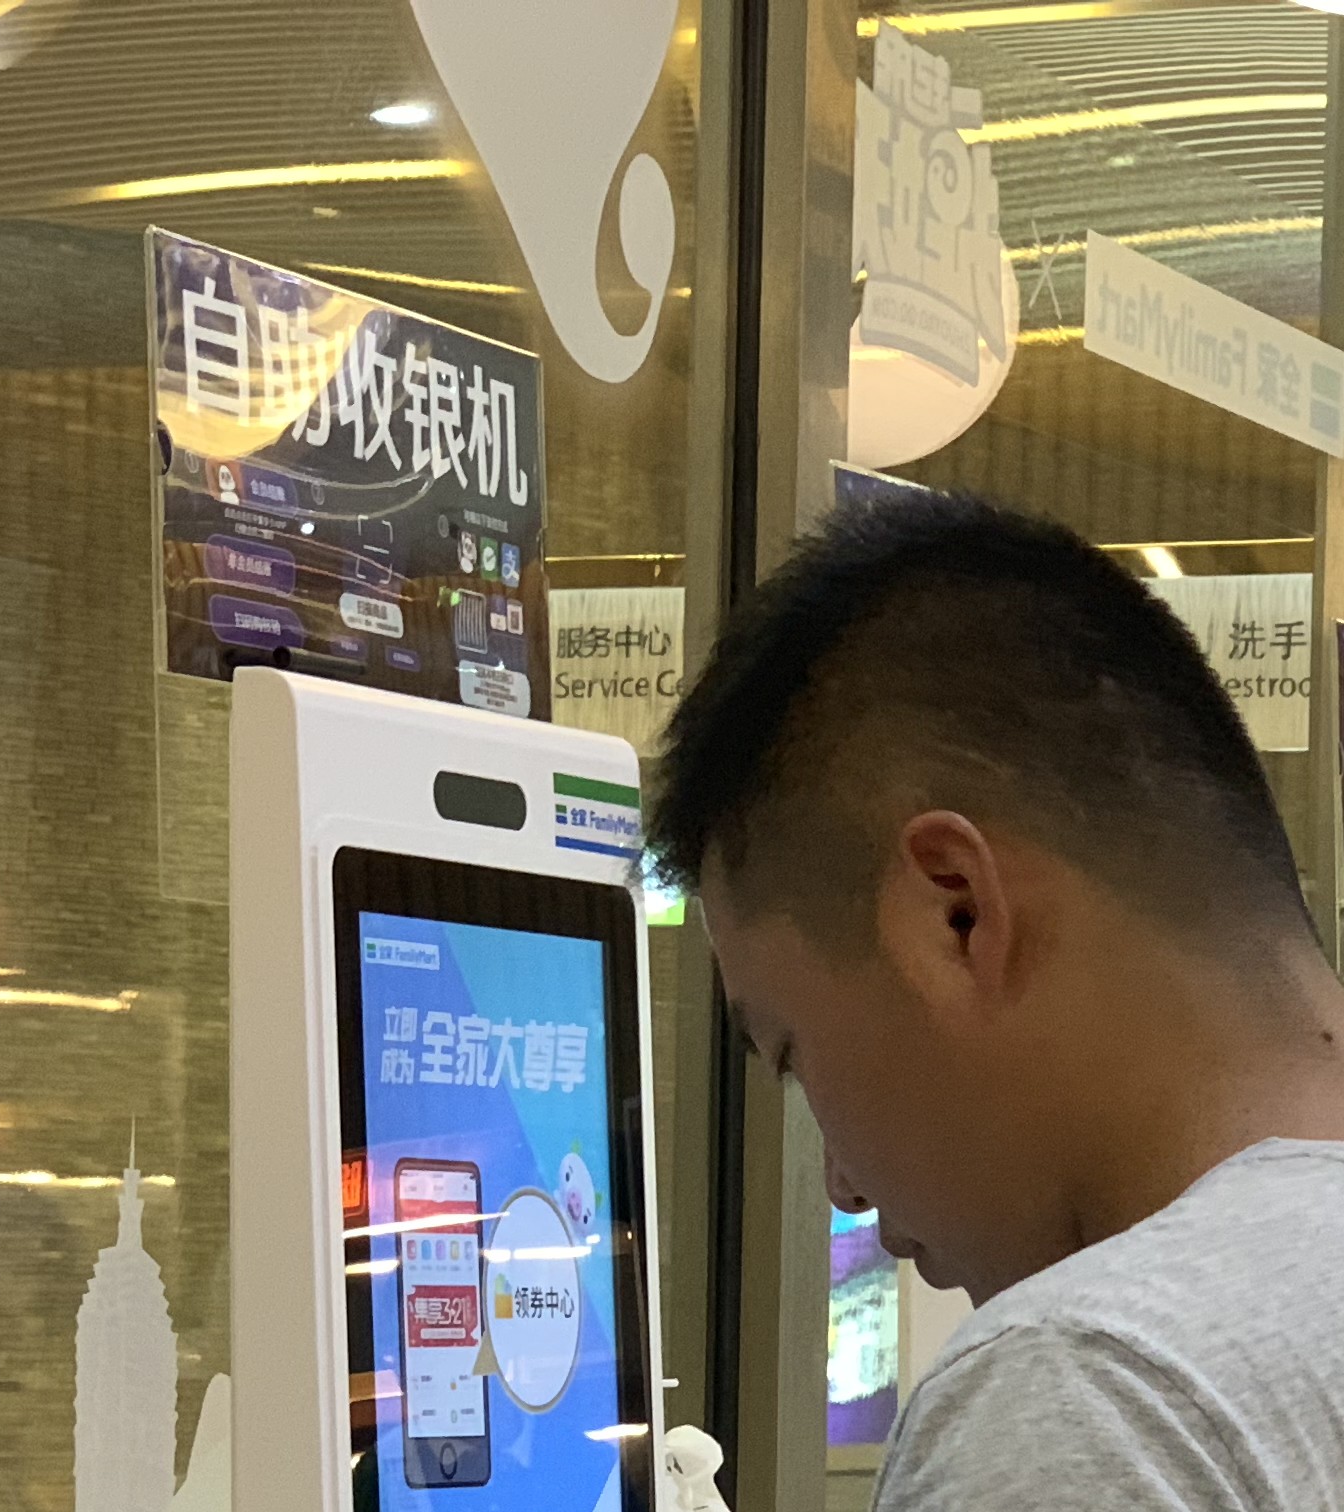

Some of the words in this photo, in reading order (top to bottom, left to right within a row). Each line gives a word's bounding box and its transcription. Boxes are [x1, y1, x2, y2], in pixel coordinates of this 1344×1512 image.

[182, 278, 527, 506] 自助收银机
[556, 624, 672, 659] 服务中心
[1228, 620, 1307, 661] 洗手
[554, 671, 650, 699] Service
[419, 1011, 589, 1093] 全家大尊享
[515, 1286, 575, 1319] 领券中心
